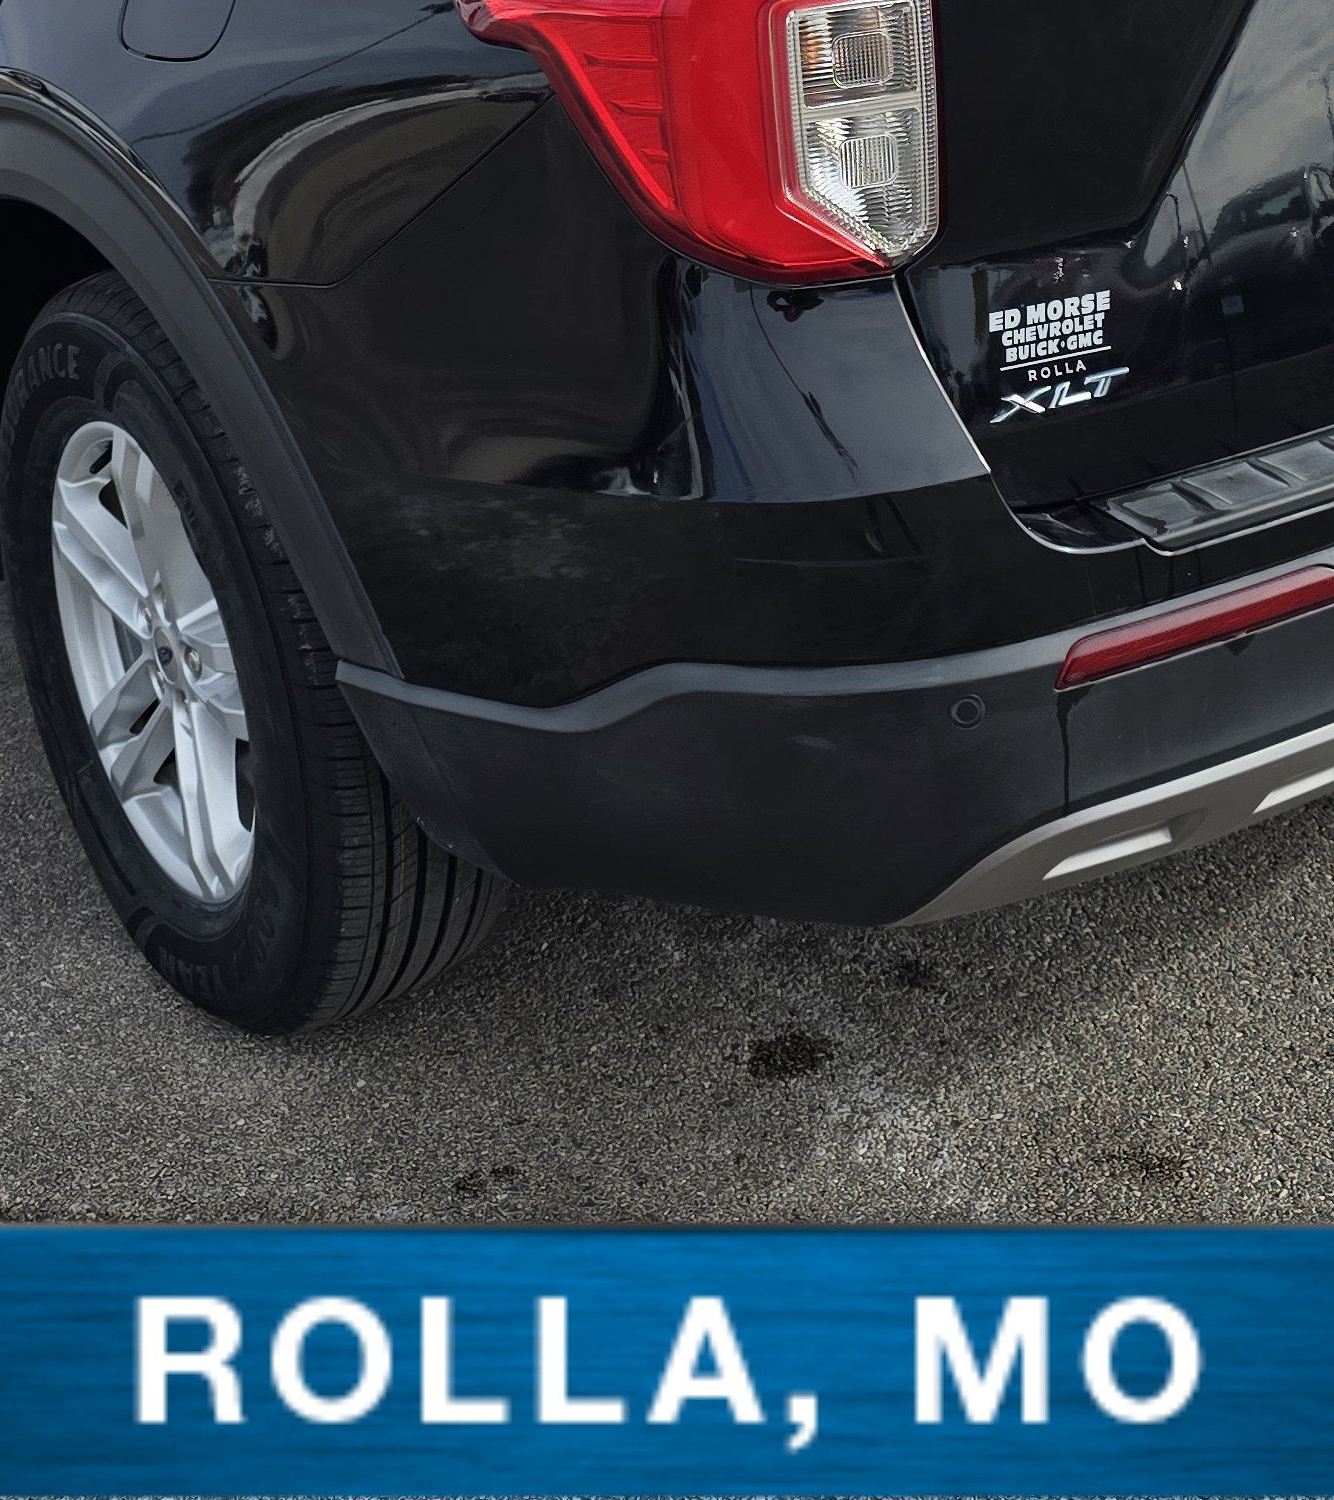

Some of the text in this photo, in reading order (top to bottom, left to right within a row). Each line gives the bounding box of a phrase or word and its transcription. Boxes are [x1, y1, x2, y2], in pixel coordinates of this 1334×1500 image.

[988, 290, 1111, 333] ED MORSE
[1001, 311, 1105, 347] CHEVROLET
[1027, 359, 1087, 382] ROLLA
[989, 366, 1130, 425] XLT
